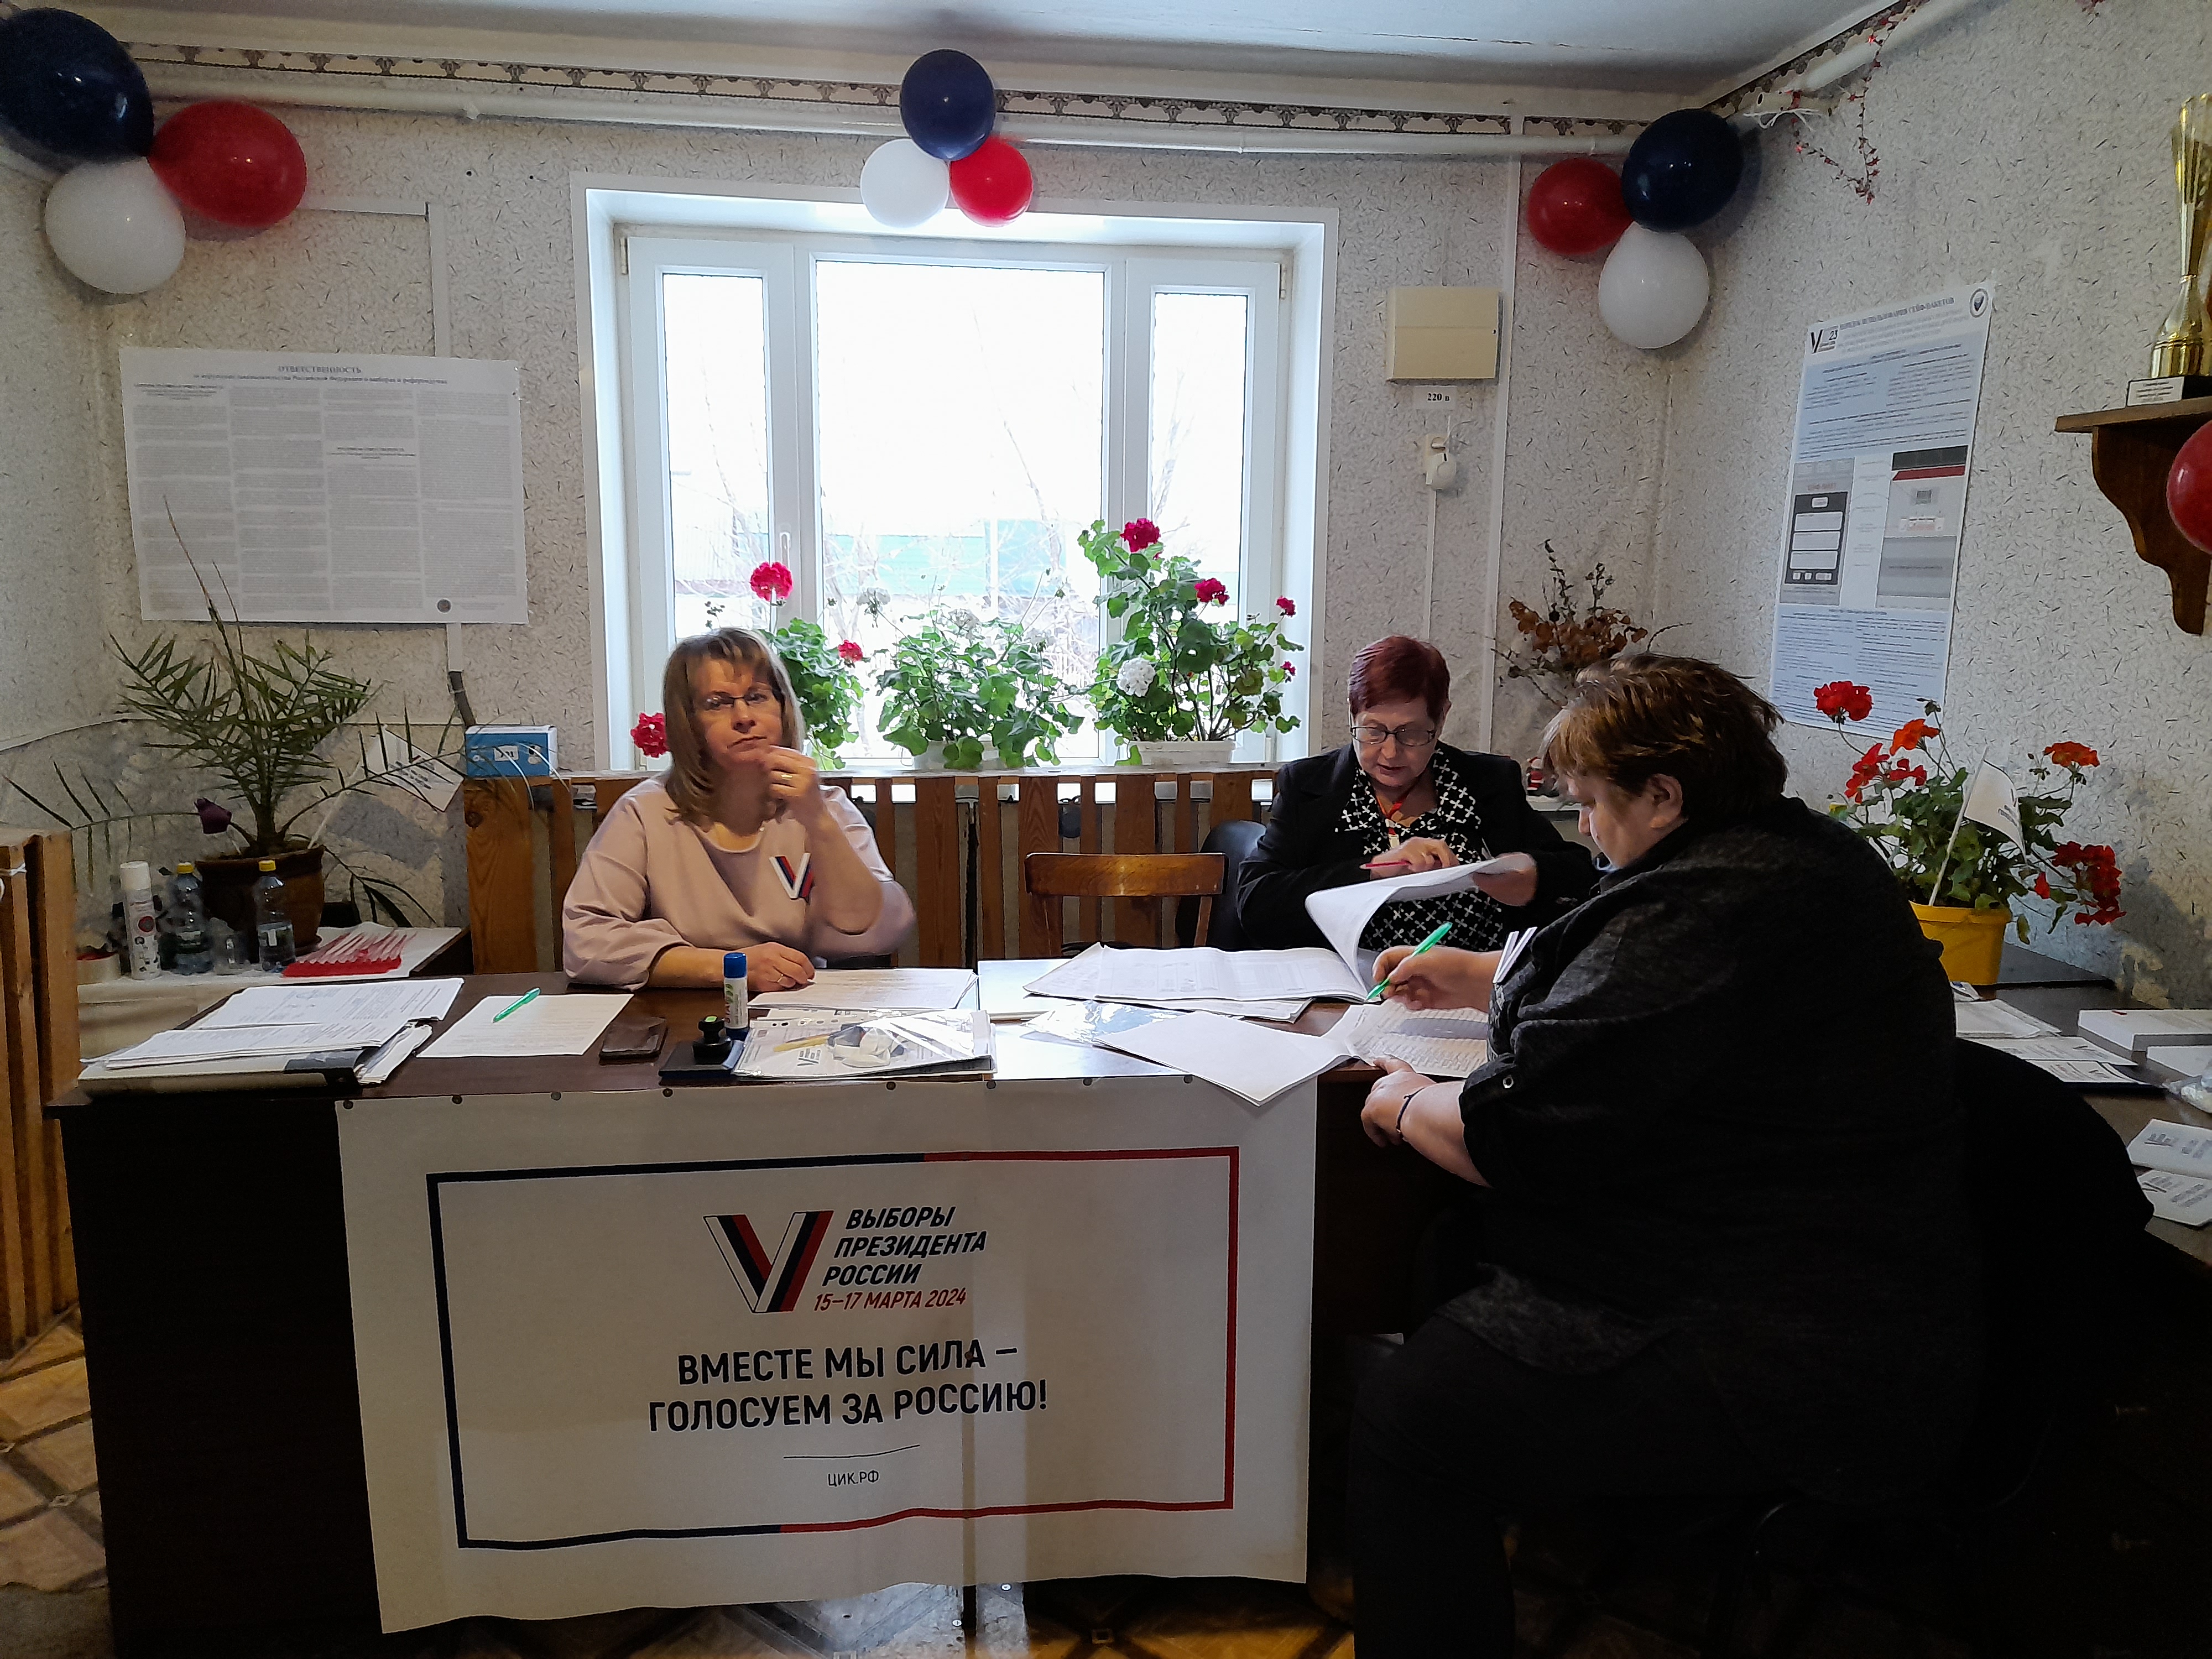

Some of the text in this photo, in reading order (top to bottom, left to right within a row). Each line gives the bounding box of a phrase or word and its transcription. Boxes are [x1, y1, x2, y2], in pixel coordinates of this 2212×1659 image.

[845, 1206, 956, 1230] ВЫБОРЫ
[833, 1231, 987, 1259] ПРЕЗИДЕНТА
[822, 1264, 922, 1287] РОССИИ
[863, 1290, 922, 1309] МАРТА
[925, 1287, 967, 1308] 2024
[678, 1348, 813, 1385] ВМЕСТЕ
[825, 1347, 884, 1379] МЫ
[896, 1339, 986, 1375] СИЛА
[649, 1379, 1047, 1432] ГОЛОСУЕМ ЗА РОССИЮ!
[827, 1469, 879, 1487] ЦИК.РФ
